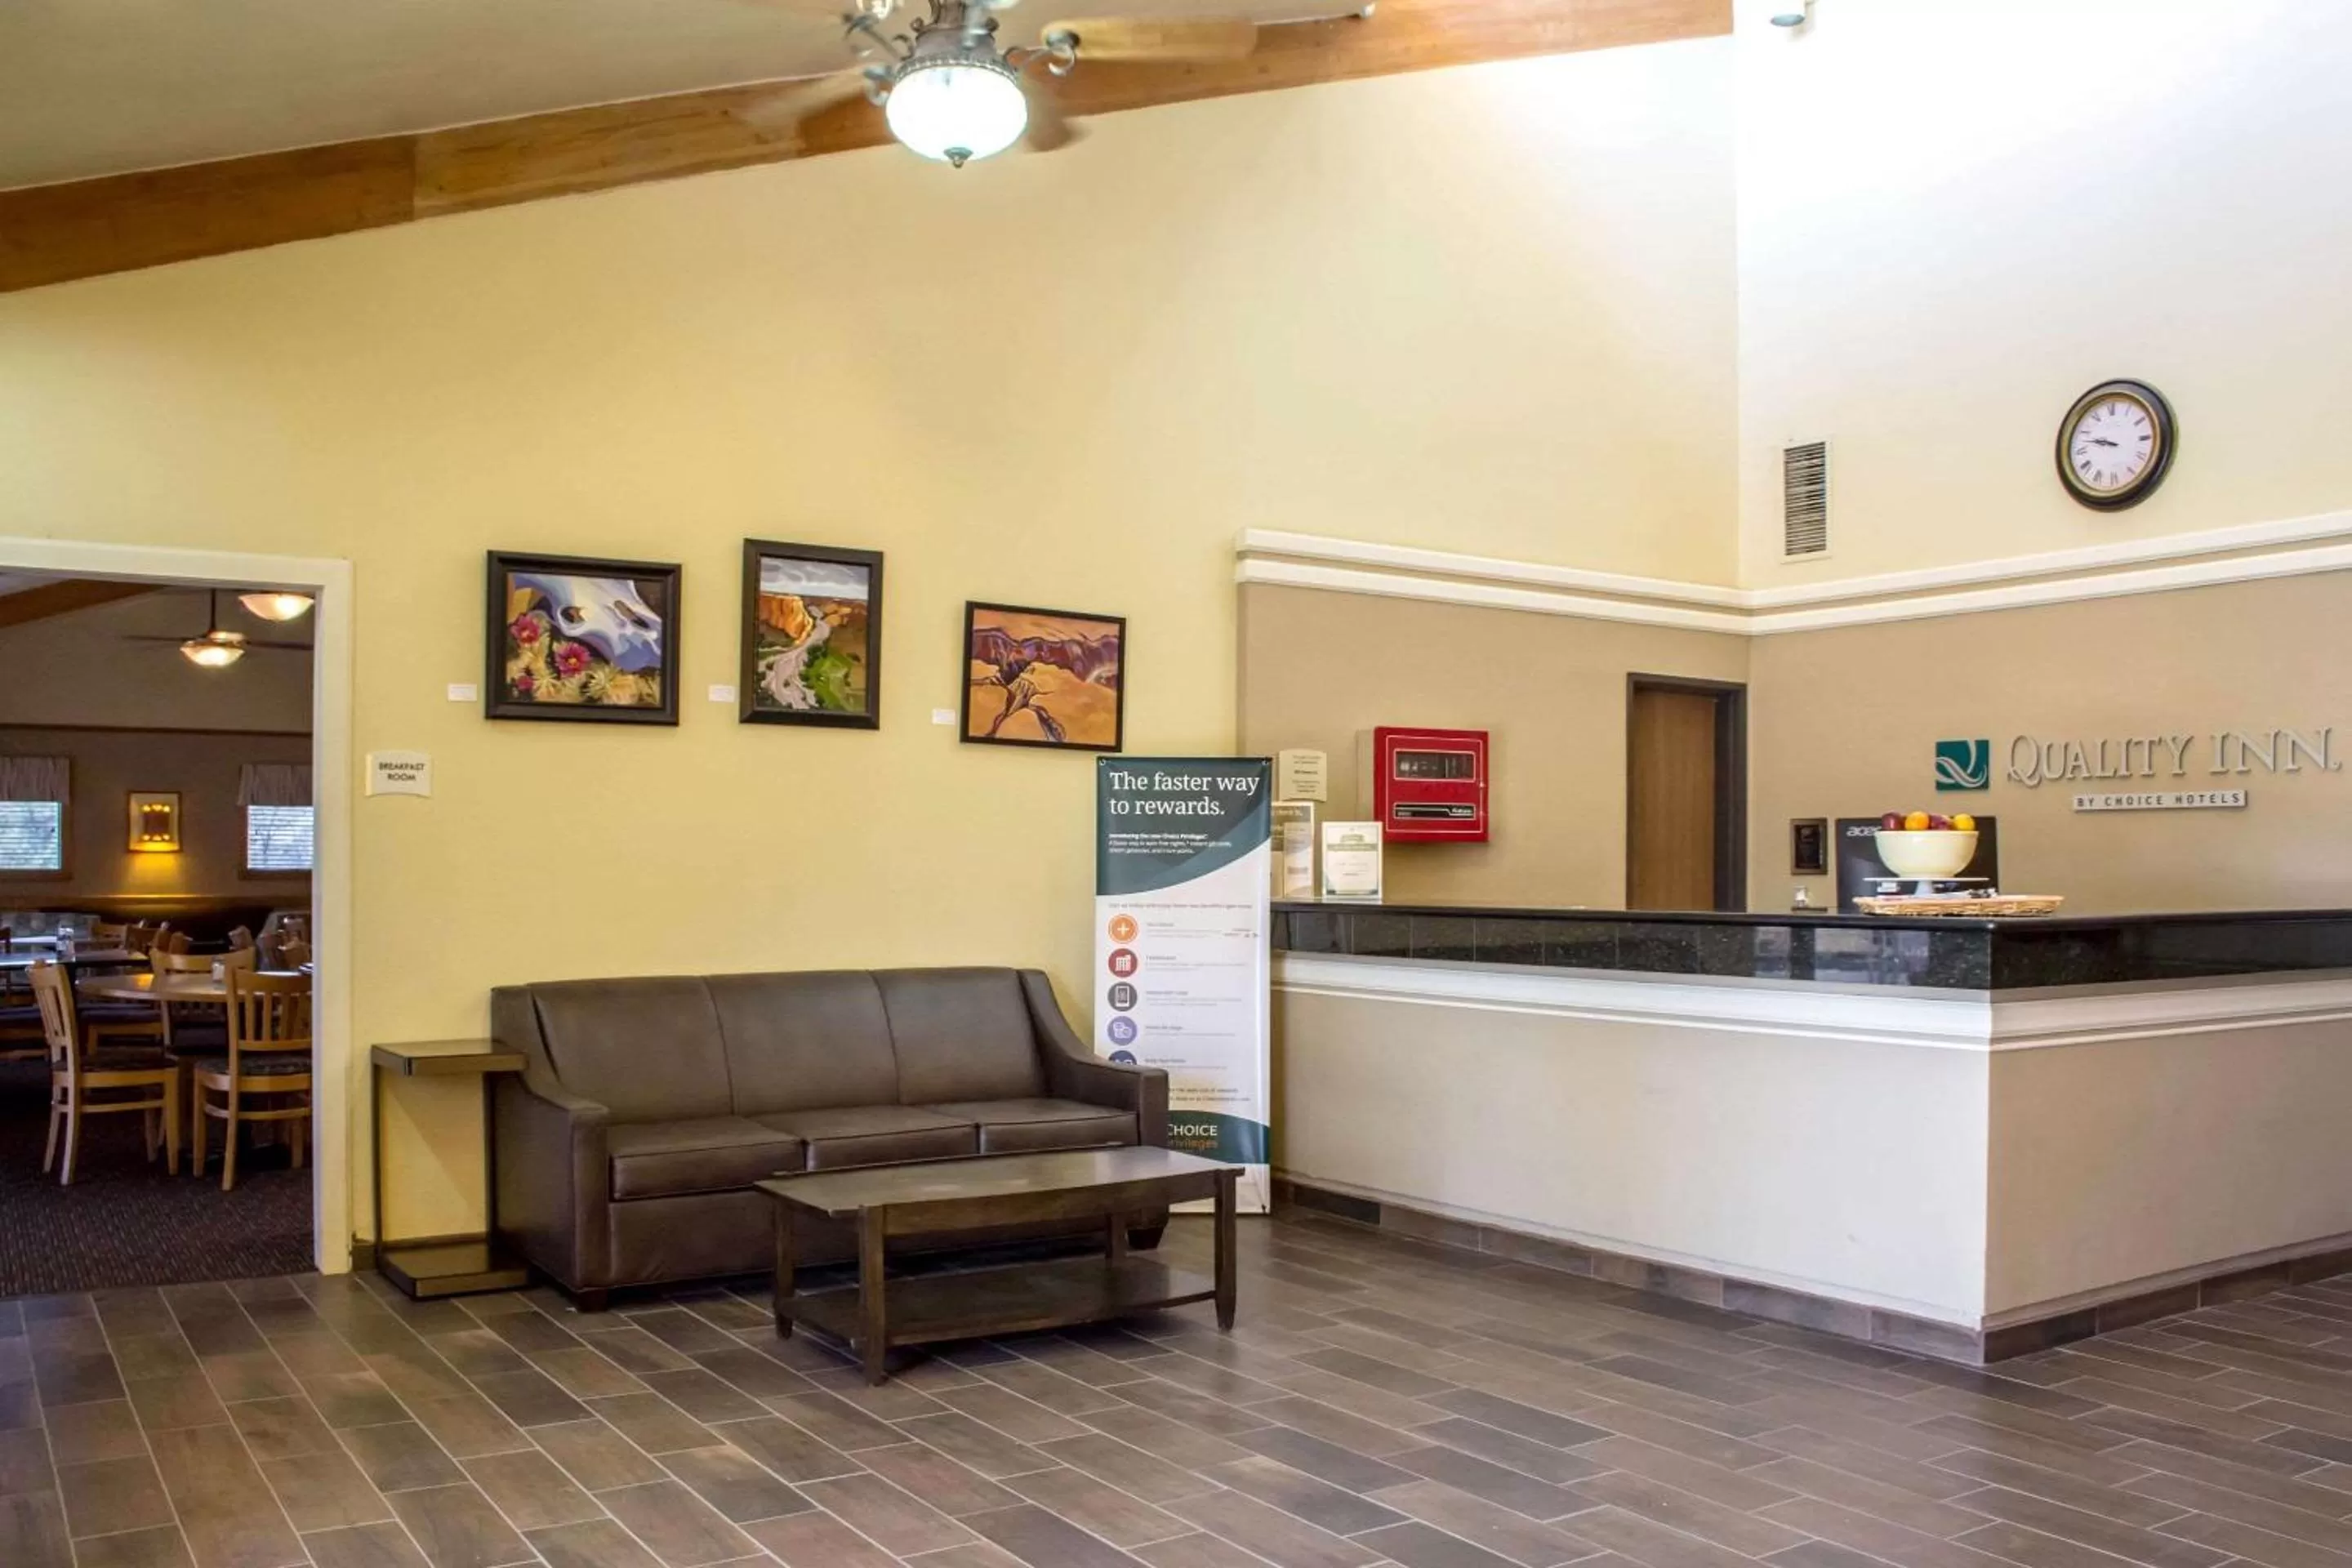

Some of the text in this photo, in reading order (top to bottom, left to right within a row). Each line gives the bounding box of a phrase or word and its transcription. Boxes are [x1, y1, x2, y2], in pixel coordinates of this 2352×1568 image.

[378, 762, 425, 771] BREAKFAST
[2007, 734, 2194, 787] QUALITY
[387, 773, 416, 782] ROOM
[1109, 771, 1260, 796] The faster way
[1109, 796, 1226, 815] to rewards.
[2077, 793, 2241, 808] BY CHOICE HOTELS
[1167, 1123, 1218, 1136] CHOICE
